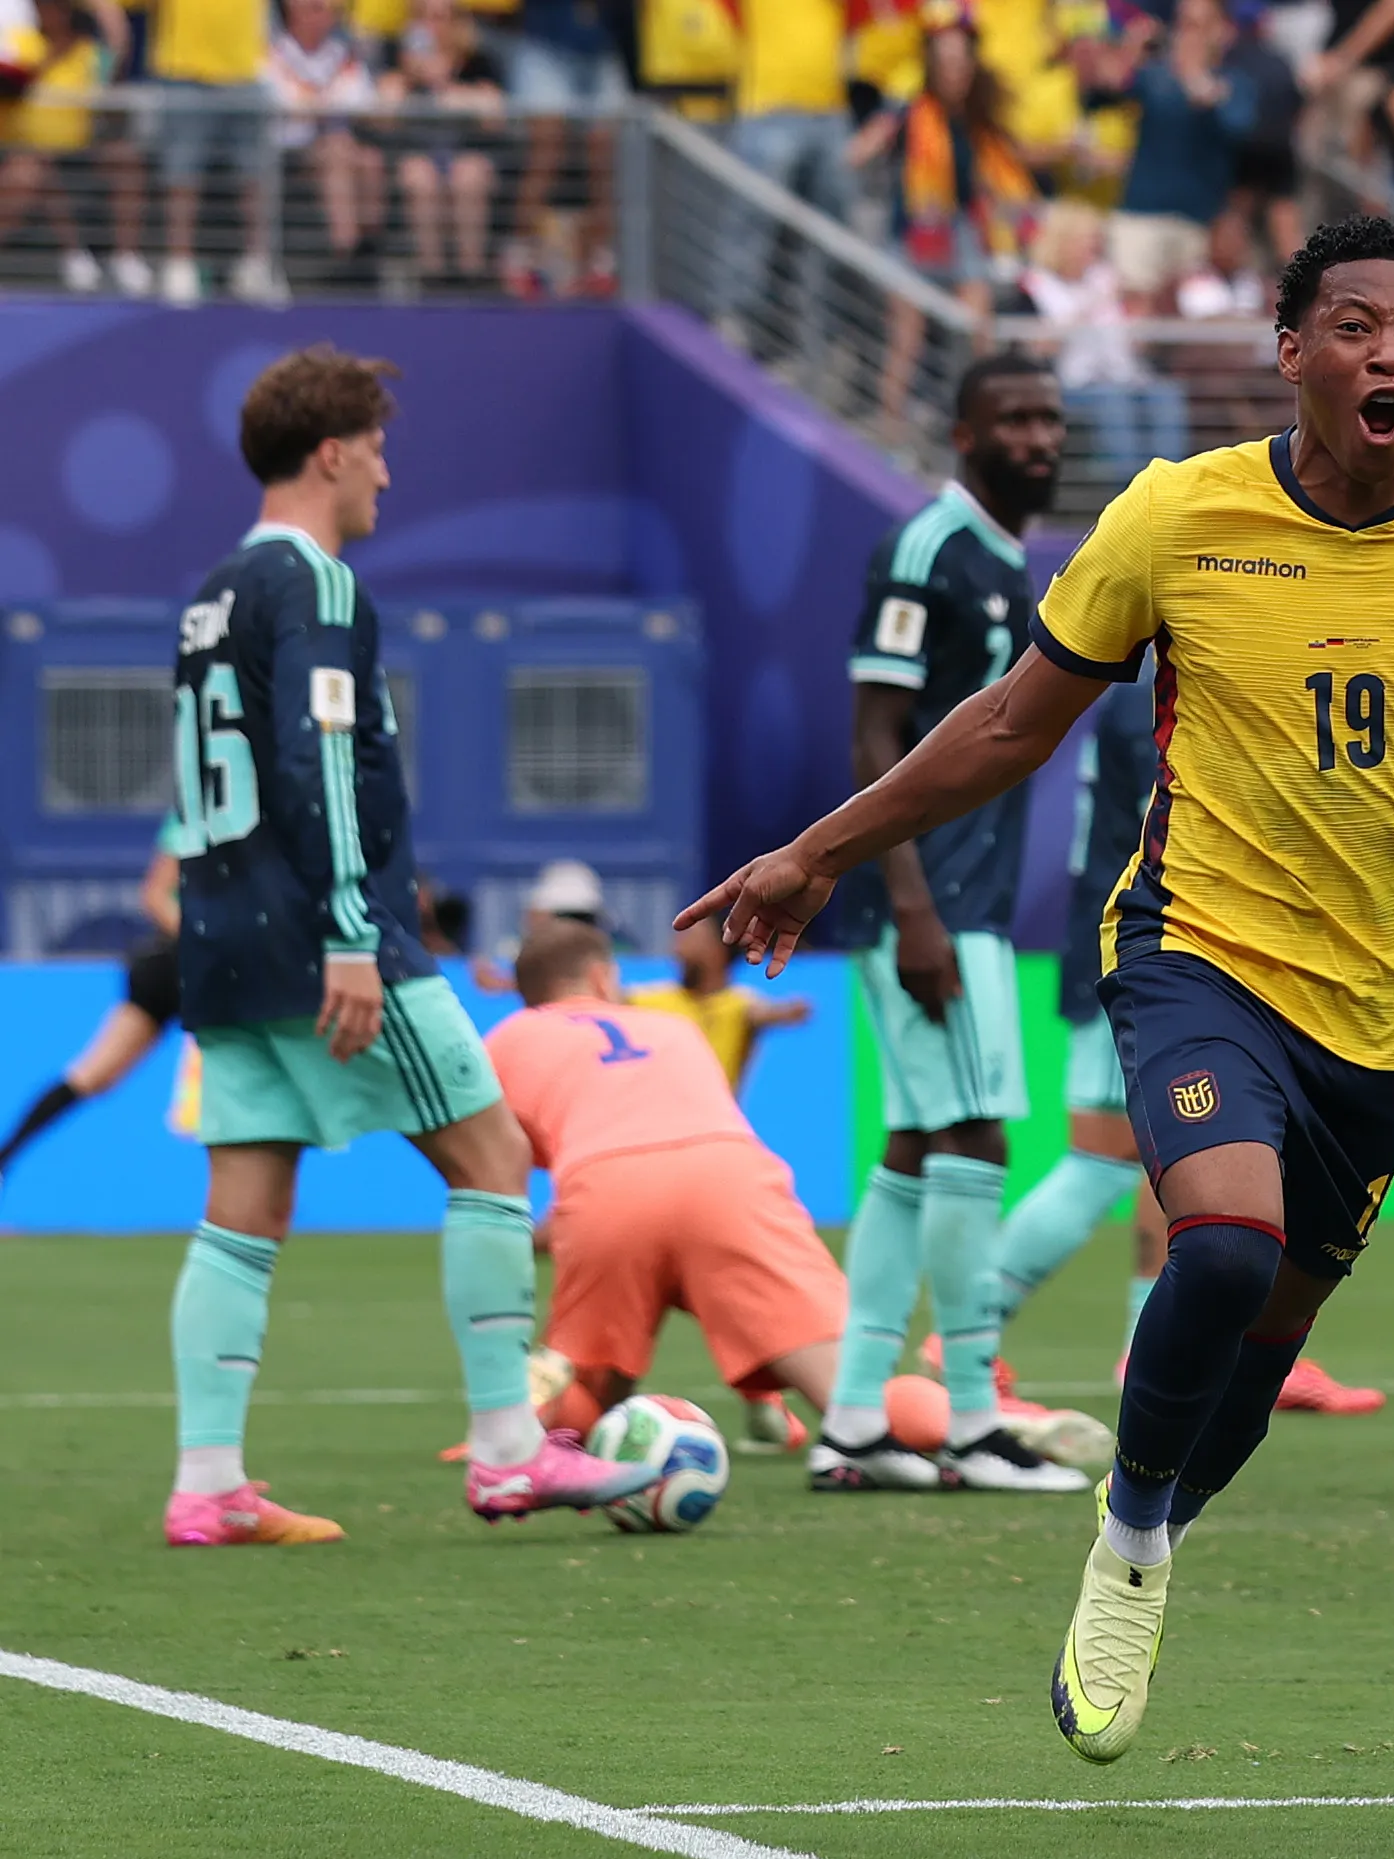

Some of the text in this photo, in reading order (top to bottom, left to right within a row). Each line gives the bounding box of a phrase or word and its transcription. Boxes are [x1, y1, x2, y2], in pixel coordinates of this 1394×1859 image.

[1197, 554, 1306, 579] marathon
[1305, 671, 1386, 772] 19
[175, 662, 260, 858] 16
[570, 1014, 649, 1064] 1
